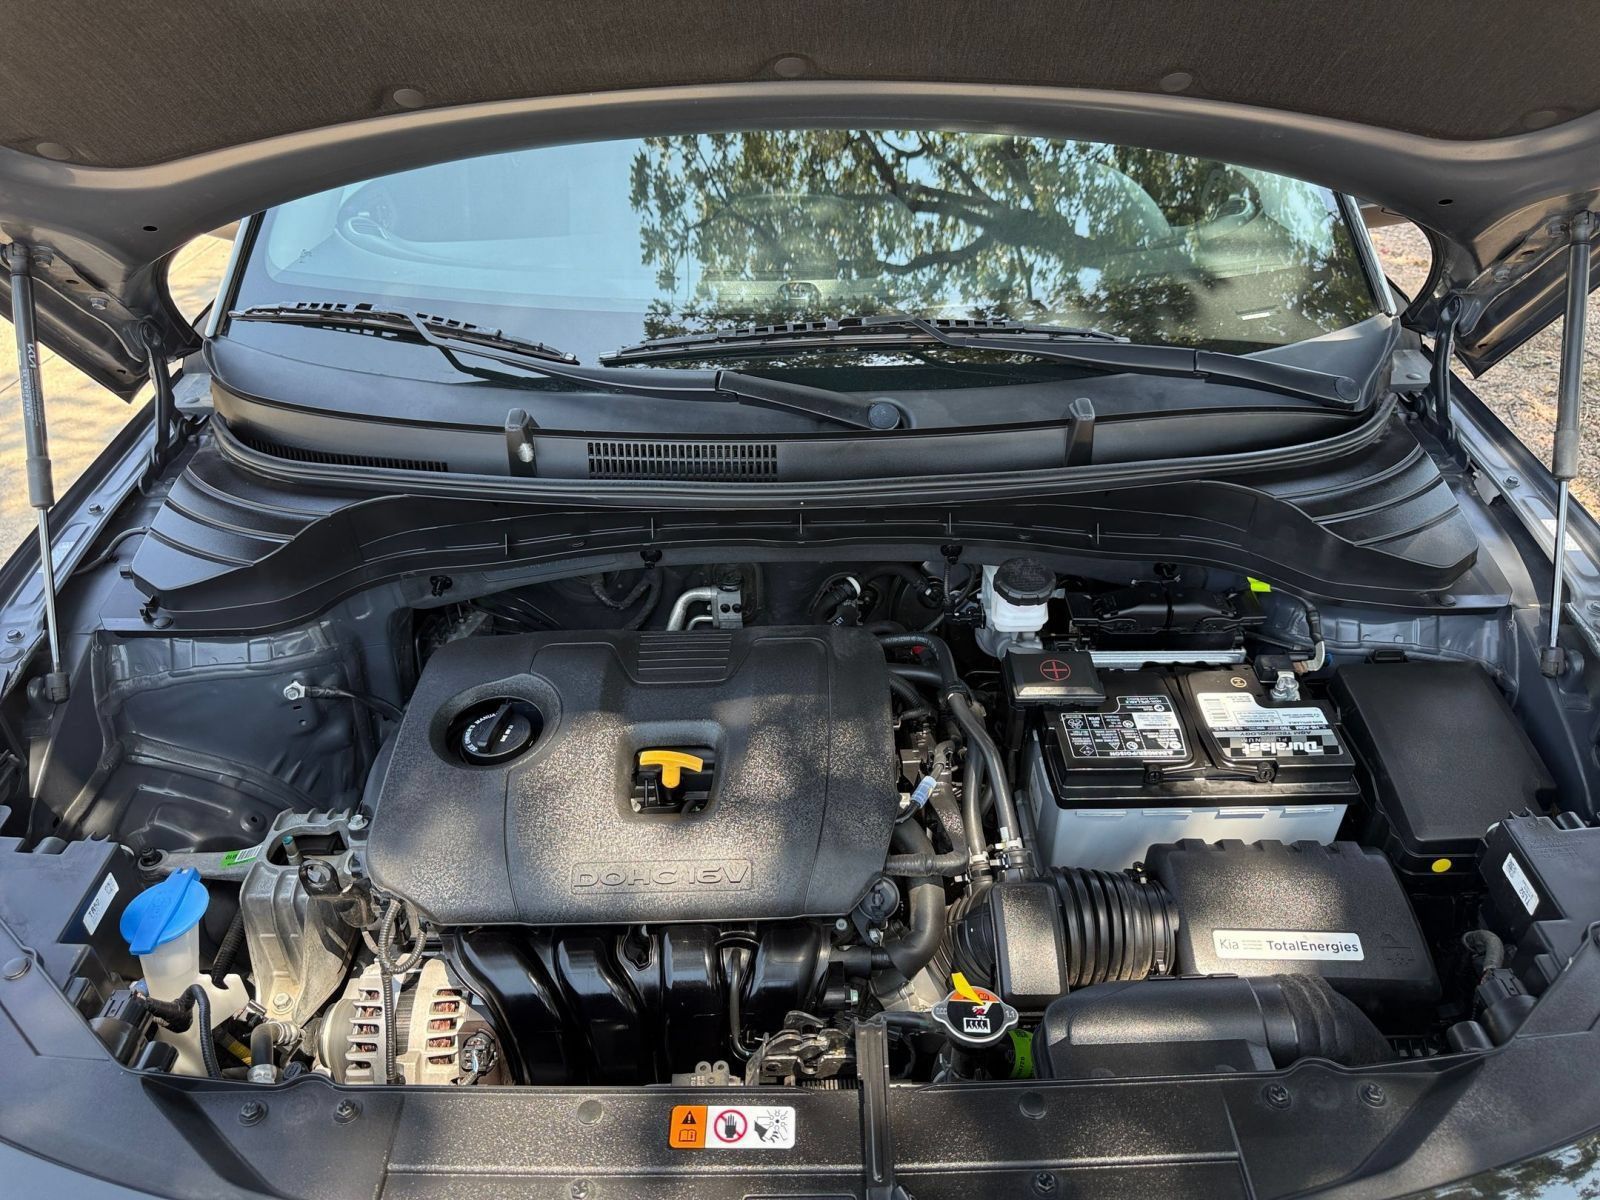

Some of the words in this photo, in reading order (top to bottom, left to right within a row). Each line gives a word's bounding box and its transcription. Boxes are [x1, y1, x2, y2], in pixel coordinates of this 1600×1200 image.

[474, 712, 497, 725] MANUA
[1241, 741, 1322, 755] Duralast
[573, 866, 679, 888] DOHC
[687, 865, 750, 886] 16V
[1219, 938, 1240, 951] Kia
[1266, 939, 1359, 954] TotalEnergies
